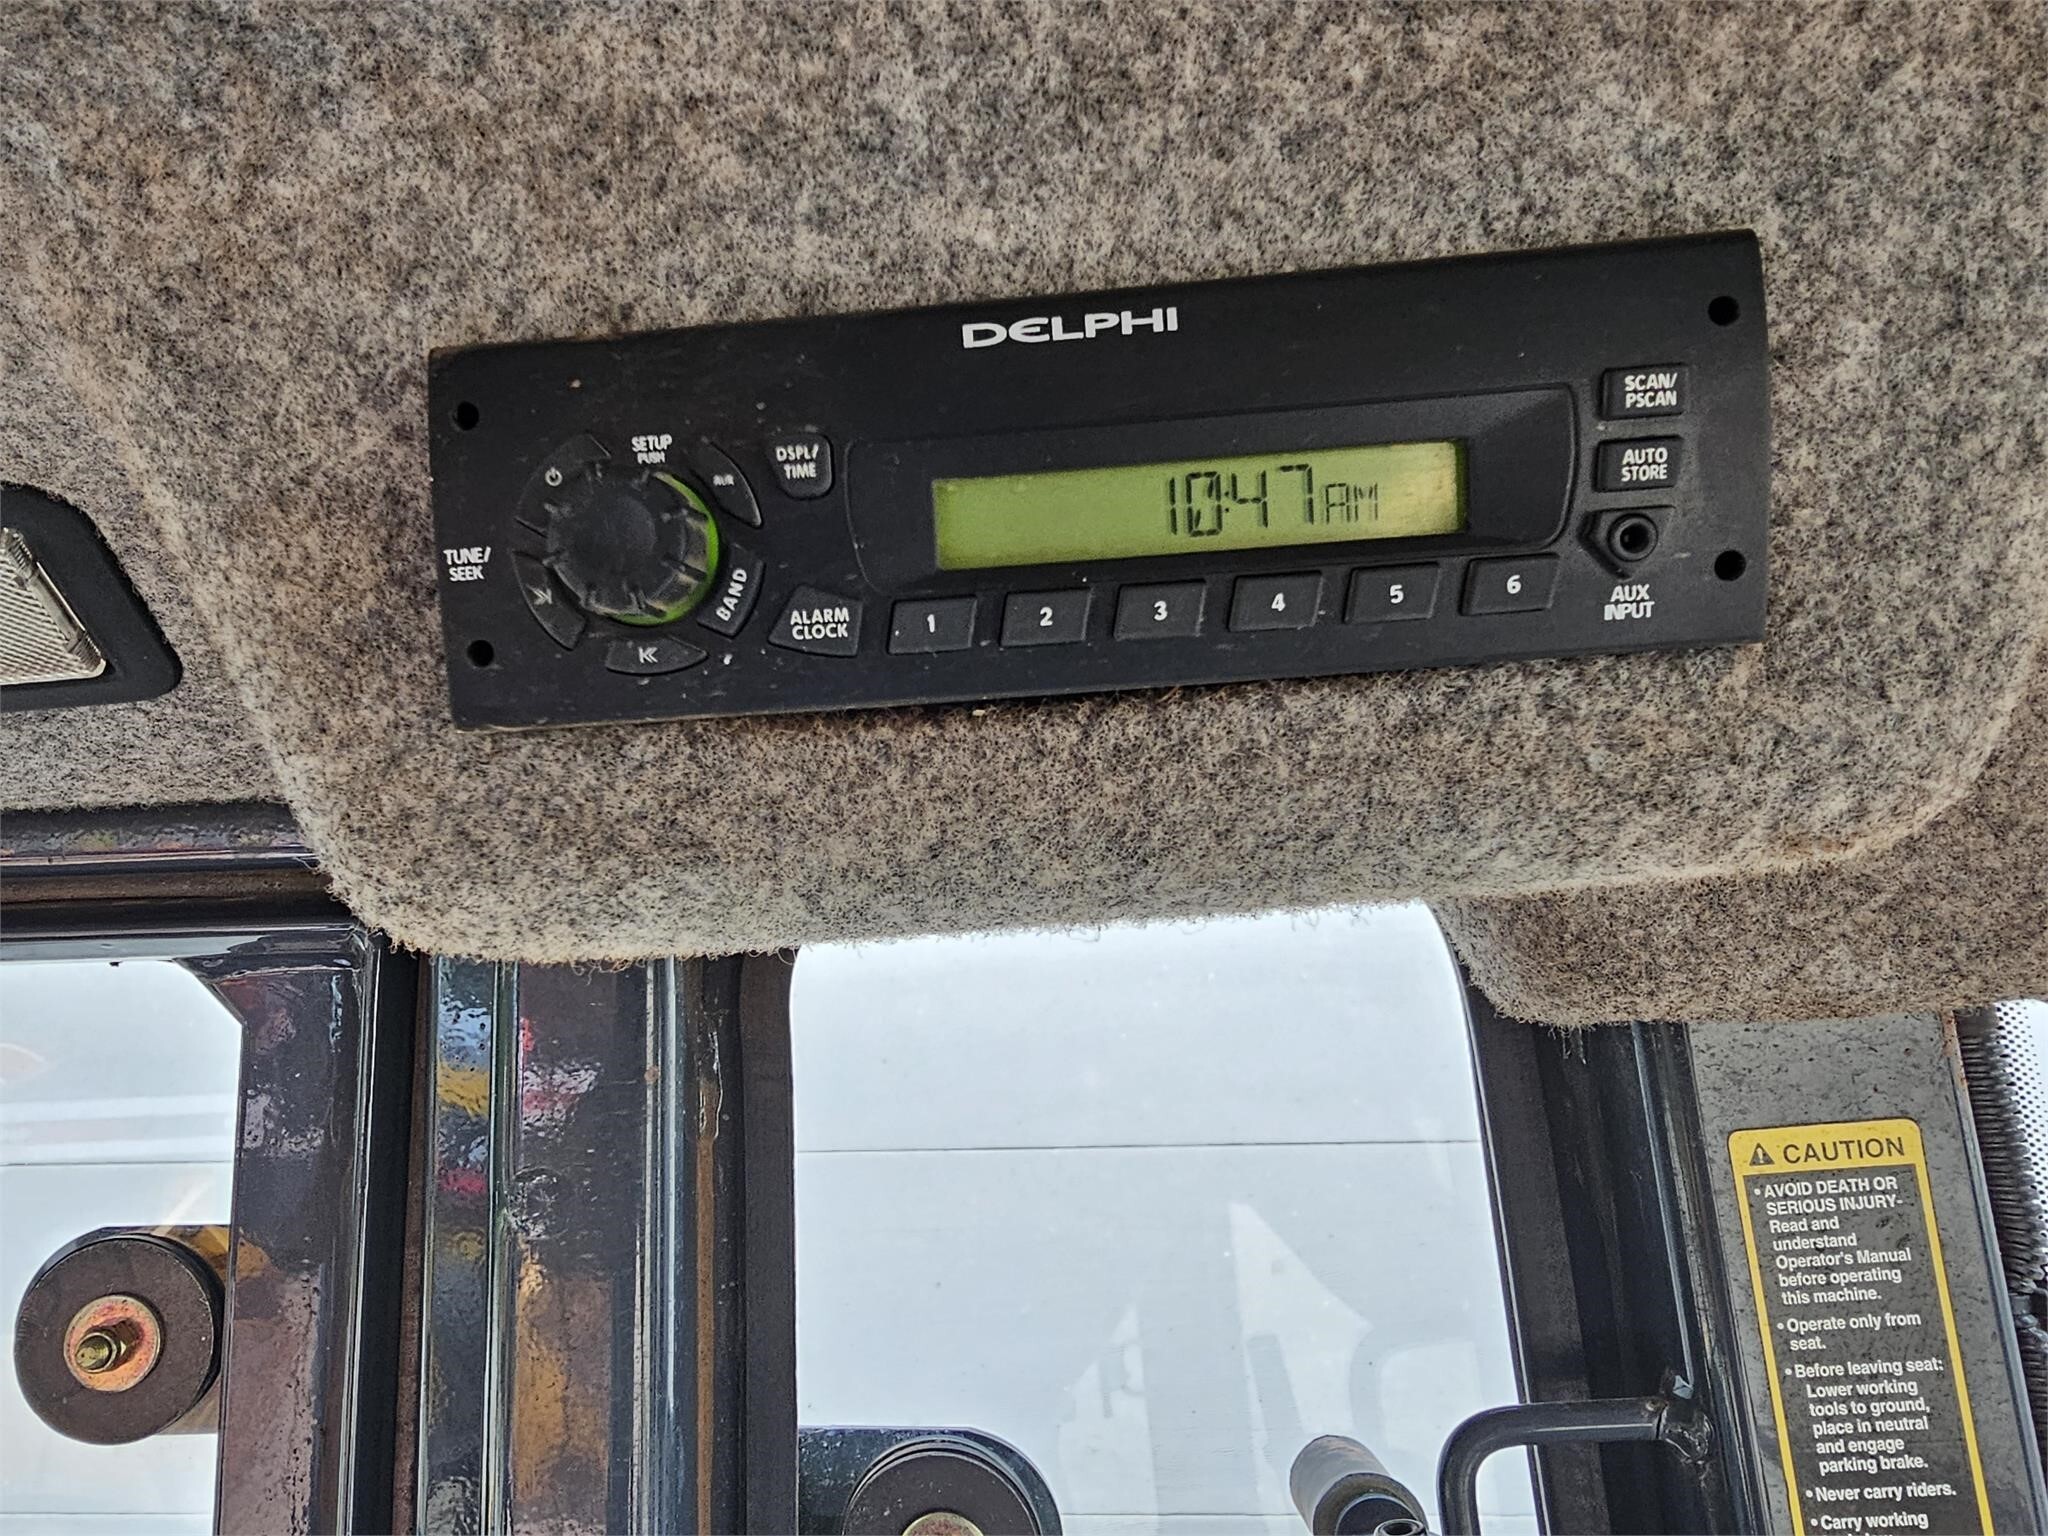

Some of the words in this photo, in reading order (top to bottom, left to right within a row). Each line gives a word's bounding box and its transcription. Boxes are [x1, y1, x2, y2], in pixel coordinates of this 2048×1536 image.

[962, 307, 1178, 348] DELPHI
[1625, 373, 1677, 392] SCAN/
[1625, 390, 1677, 408] PSCAN
[632, 433, 672, 452] SETUP
[637, 451, 665, 464] PUSH
[776, 444, 819, 461] DSPL/
[1622, 447, 1668, 466] AUTO
[784, 462, 817, 480] TIME
[1621, 464, 1667, 482] STORE
[1169, 464, 1314, 537] 10:47
[1325, 483, 1378, 524] AM
[443, 546, 491, 566] TUNE/
[448, 564, 485, 582] SEEK
[1390, 584, 1404, 603] 5
[1507, 574, 1521, 594] 6
[1610, 584, 1650, 603] AUX
[716, 567, 747, 622] BAND
[1271, 592, 1285, 611] 4
[790, 606, 850, 626] ALARM
[1040, 607, 1053, 626] 2
[1154, 601, 1168, 621] 3
[1604, 601, 1654, 621] INPUT
[792, 623, 849, 641] CLOCK
[927, 614, 935, 633] 1
[1783, 1137, 1904, 1164] CAUTION
[1764, 1181, 1812, 1198] AVOID
[1816, 1178, 1869, 1194] DEATH
[1874, 1176, 1897, 1190] OR
[1766, 1199, 1836, 1215] SERIOUS
[1769, 1218, 1808, 1233] Read
[1812, 1216, 1839, 1230] and
[1773, 1233, 1857, 1251] understand
[1776, 1252, 1853, 1271] Operator's
[1857, 1247, 1911, 1264] Manual
[1779, 1273, 1826, 1287] before
[1830, 1268, 1902, 1286] operating
[1782, 1291, 1810, 1305] this
[1814, 1287, 1882, 1302] machine.
[1787, 1316, 1846, 1334] Operate
[1850, 1314, 1881, 1330] only
[1885, 1313, 1921, 1326] from
[1790, 1336, 1826, 1350] seat.
[1794, 1363, 1844, 1378] Before
[1848, 1360, 1903, 1375] leaving
[1906, 1357, 1944, 1371] seat:
[1806, 1384, 1852, 1398] Lower
[1856, 1380, 1918, 1395] working
[1809, 1402, 1848, 1416] tools
[1850, 1401, 1867, 1414] to
[1871, 1398, 1930, 1416] ground,
[1813, 1421, 1854, 1438] place
[1857, 1419, 1872, 1433] in
[1875, 1416, 1928, 1432] neutral
[1816, 1439, 1845, 1454] and
[1848, 1438, 1904, 1454] engage
[1819, 1457, 1877, 1476] parking
[1880, 1455, 1928, 1470] brake.
[1816, 1487, 1860, 1502] Never
[1864, 1486, 1902, 1501] carry
[1906, 1482, 1957, 1497] riders.
[1821, 1515, 1862, 1532] Carry
[1866, 1512, 1929, 1529] working
